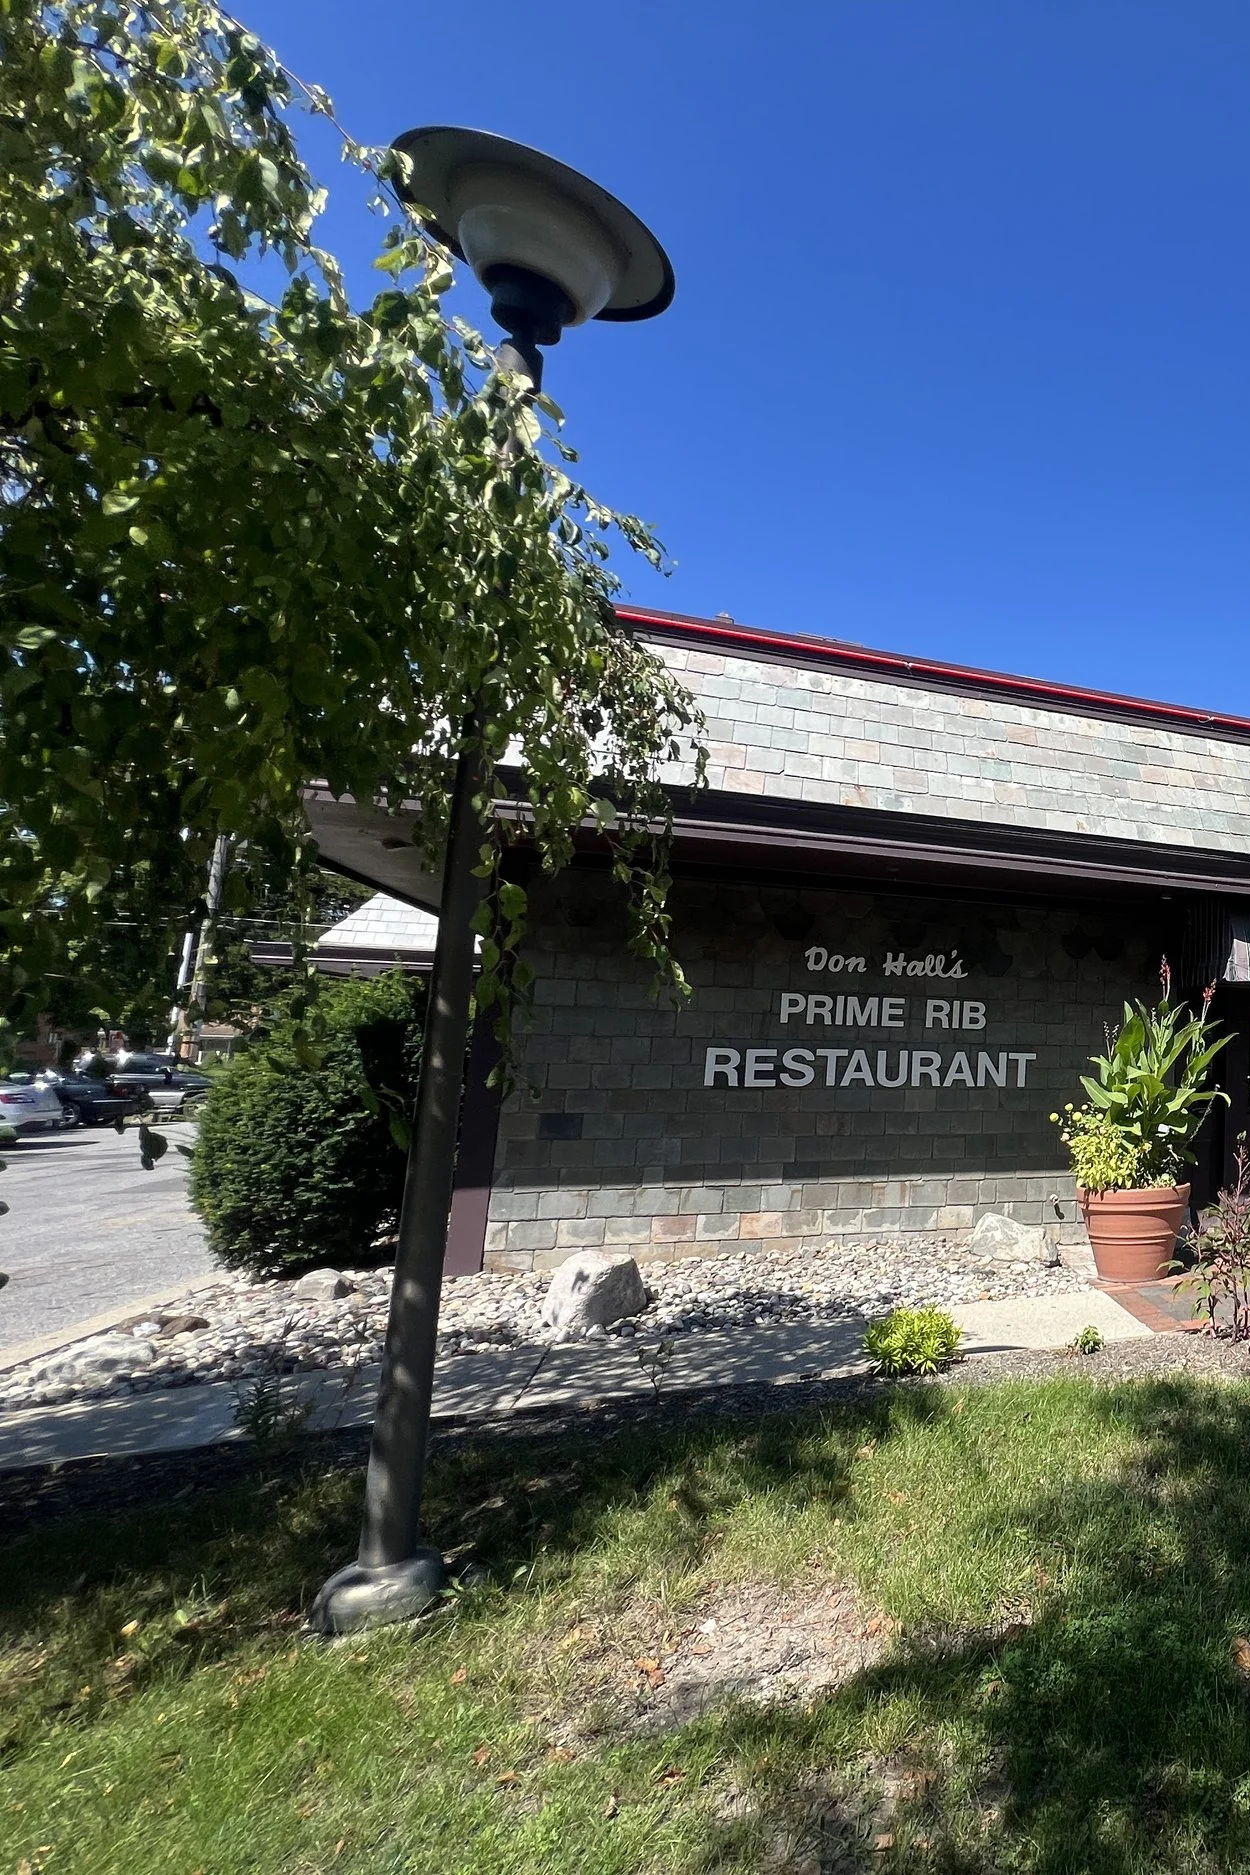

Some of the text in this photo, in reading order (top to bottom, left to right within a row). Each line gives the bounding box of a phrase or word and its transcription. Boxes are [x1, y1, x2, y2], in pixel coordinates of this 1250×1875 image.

[804, 945, 969, 979] Don Hall's
[779, 992, 987, 1030] PRIME RIB
[703, 1047, 1037, 1088] RESTAURANT
